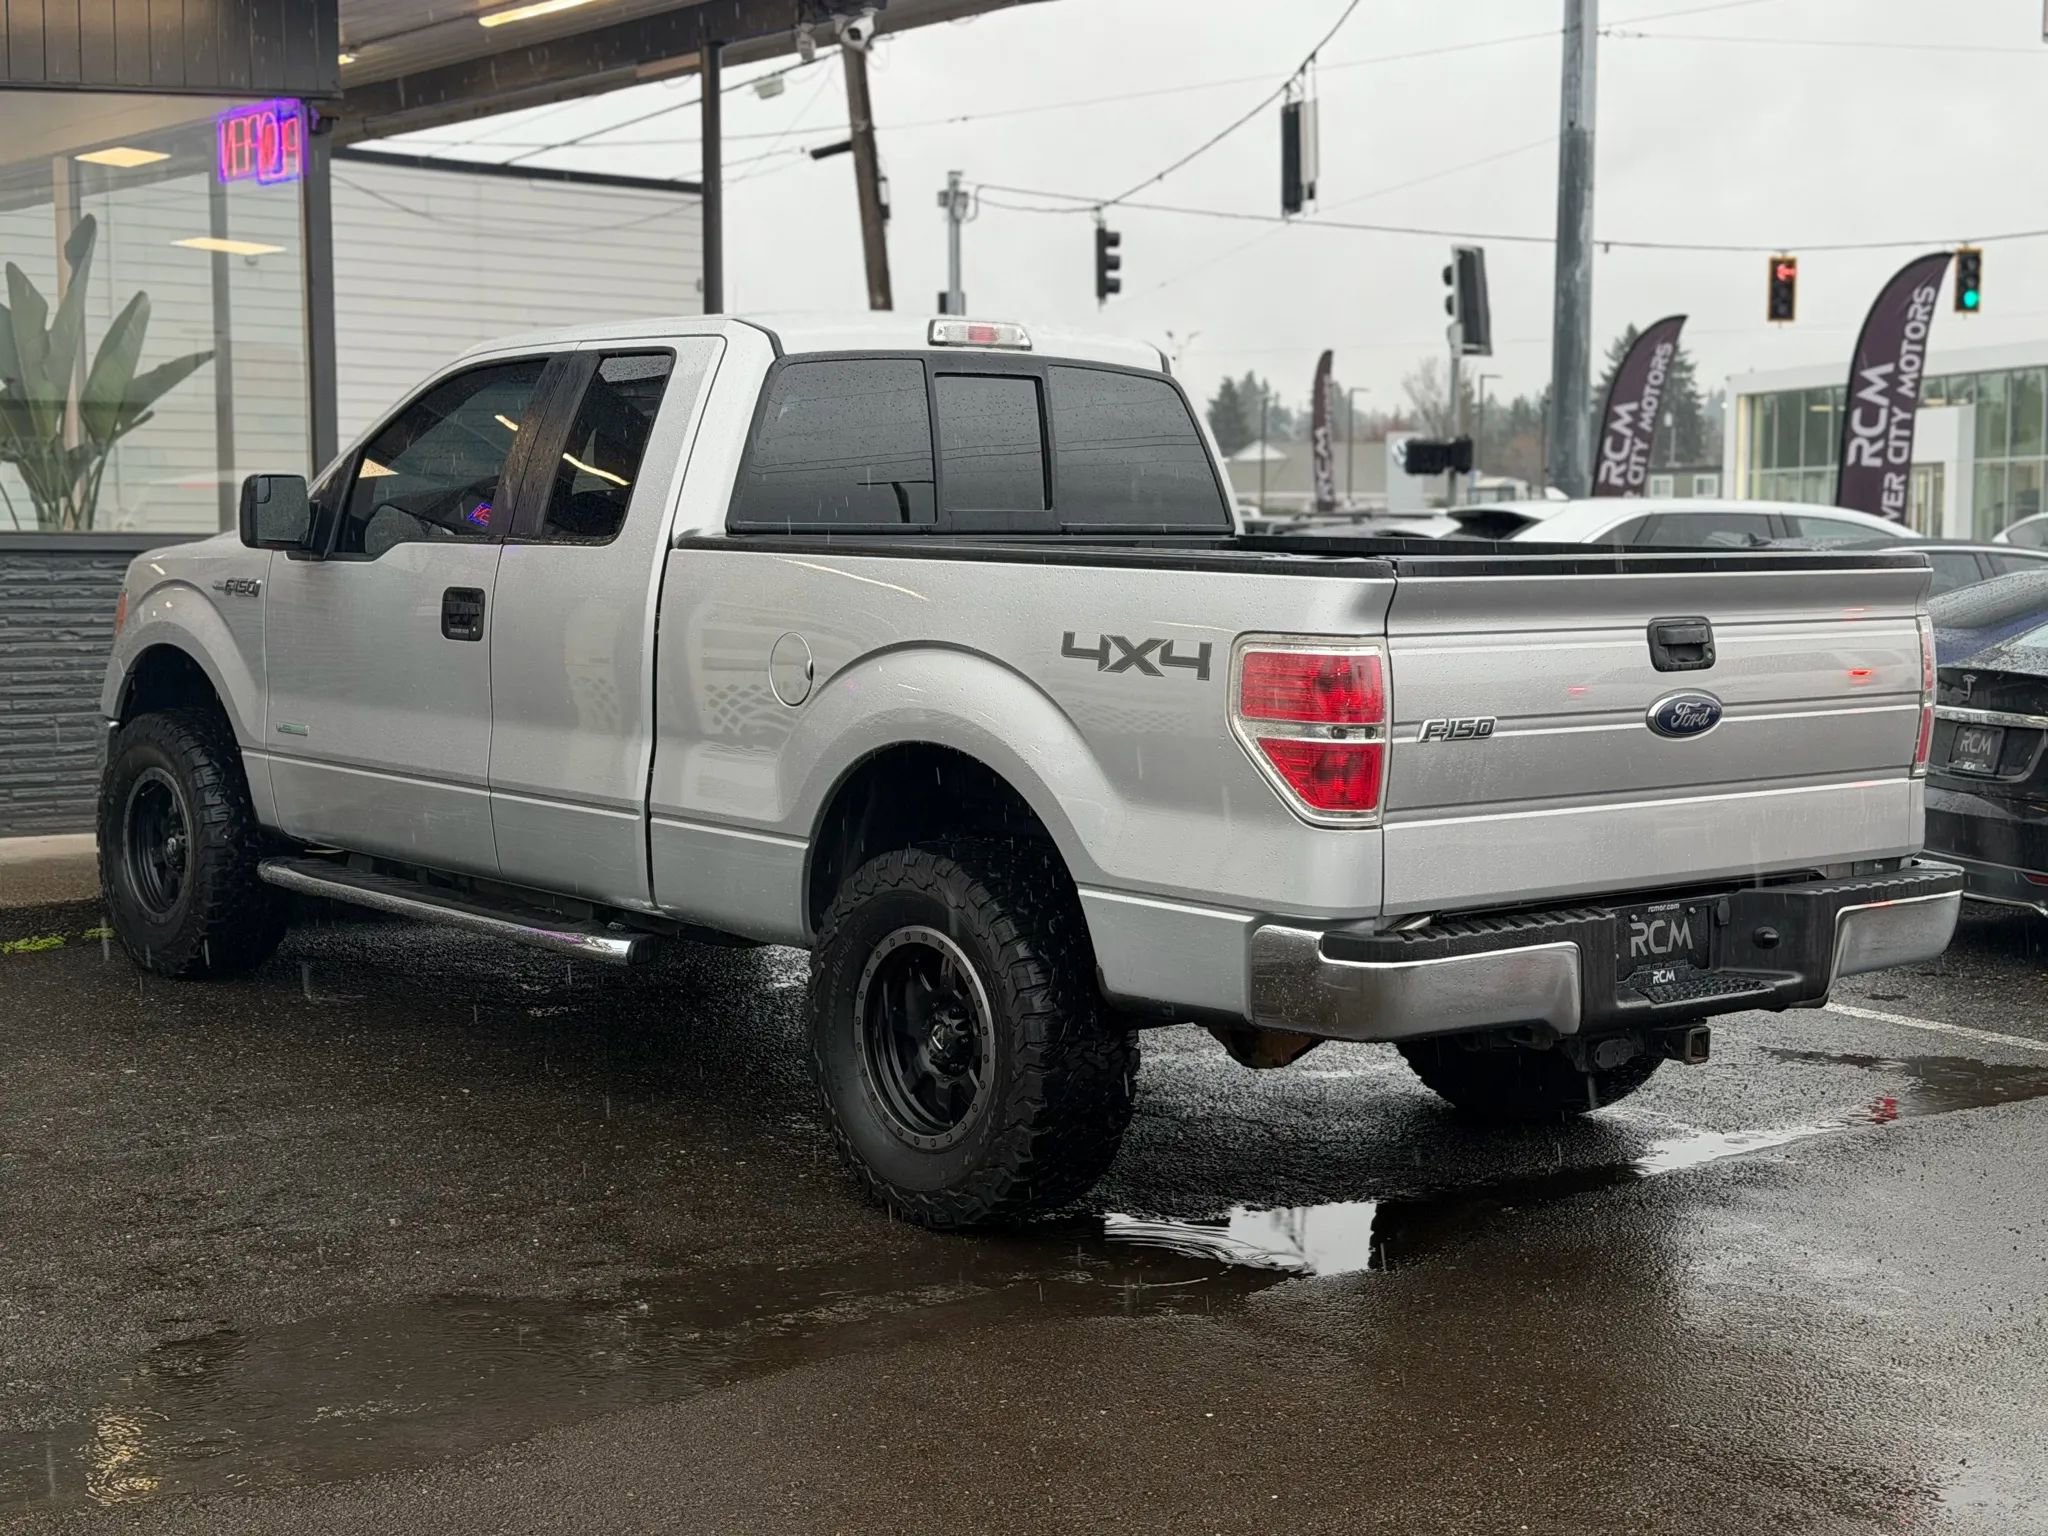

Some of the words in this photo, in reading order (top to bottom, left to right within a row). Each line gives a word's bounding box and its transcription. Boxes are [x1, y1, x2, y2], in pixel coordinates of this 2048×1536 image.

[1896, 286, 1935, 399] MOTORS
[1627, 437, 1649, 485] CITY
[1638, 342, 1673, 432] MOTORS
[1847, 362, 1895, 467] RCM
[1887, 406, 1912, 464] CITY
[1598, 401, 1639, 486] RCM
[1881, 473, 1906, 522] VER
[1061, 631, 1212, 681] 4X4
[1416, 716, 1497, 742] F-150
[1670, 702, 1711, 728] Ford
[1960, 732, 1992, 755] RCM
[1647, 903, 1680, 913] rcmor.com
[1630, 917, 1694, 957] RCM
[1652, 969, 1676, 984] RCM
